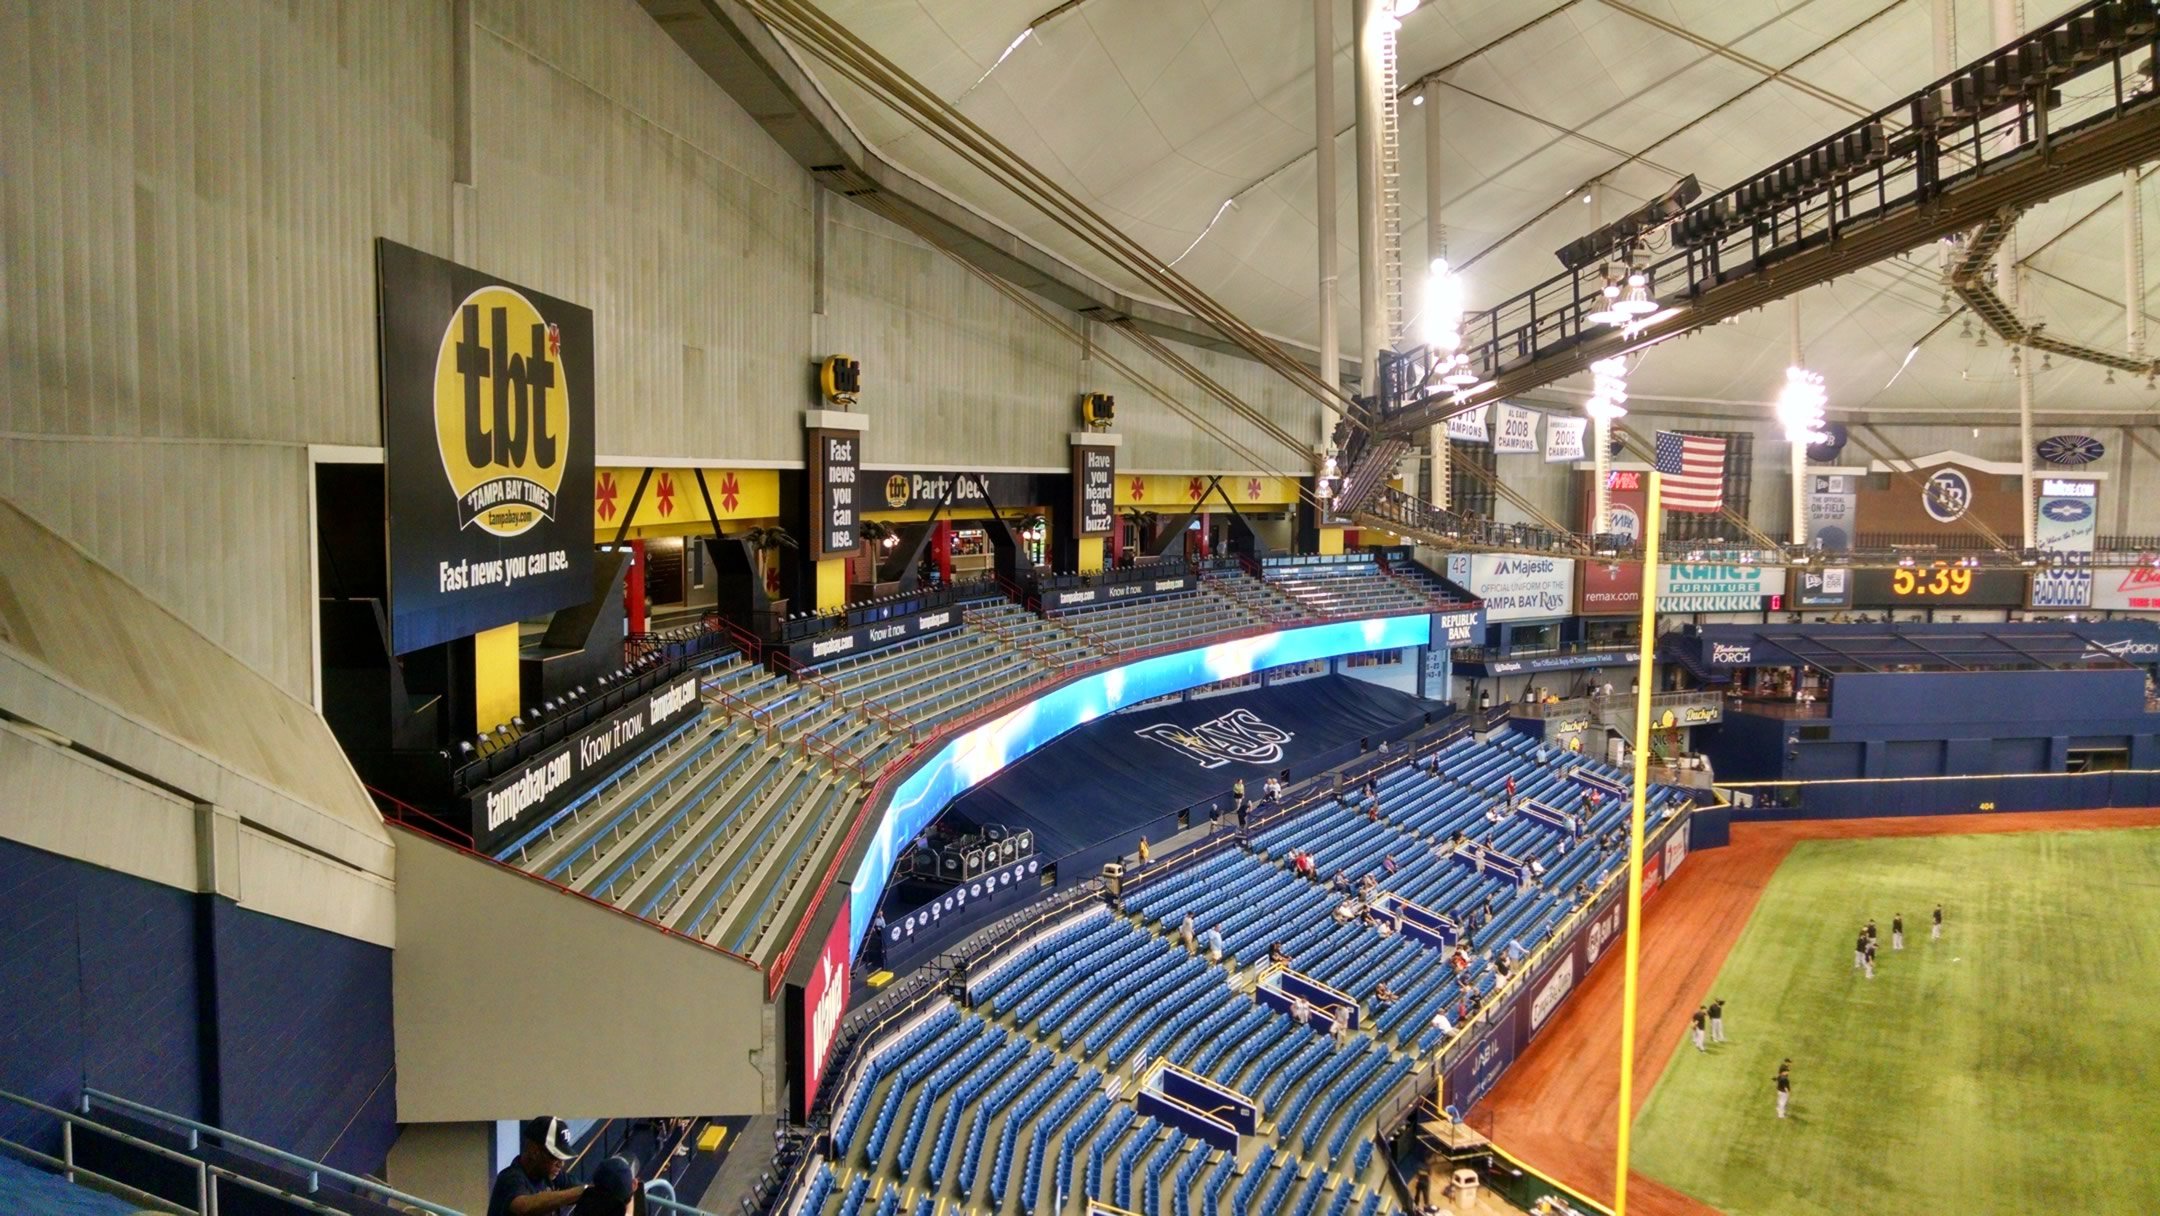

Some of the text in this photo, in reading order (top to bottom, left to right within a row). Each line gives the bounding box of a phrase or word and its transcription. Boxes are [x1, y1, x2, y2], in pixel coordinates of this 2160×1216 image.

[456, 304, 557, 469] tbt
[1505, 420, 1529, 437] 2008
[1498, 436, 1534, 449] CHAMPIONS
[1555, 431, 1575, 446] 2008
[830, 439, 852, 462] Fast
[1548, 447, 1580, 457] CHAMPIONS
[1088, 452, 1110, 468] Have
[829, 465, 856, 483] news
[1091, 471, 1108, 487] you
[472, 480, 550, 511] TAMPA BAY TIMES
[889, 476, 907, 499] tbt
[912, 474, 989, 505] Party Deck
[1086, 483, 1112, 500] heard
[1934, 479, 1963, 512] TB
[833, 487, 852, 509] you
[1091, 500, 1107, 515] the
[1811, 504, 1845, 513] ON-FIELD
[488, 510, 532, 528] tampabay.com
[833, 509, 852, 526] can
[1086, 516, 1112, 532] buzz?
[832, 530, 853, 548] use.
[440, 550, 569, 593] Fast news you can use.
[1452, 557, 1467, 574] 42
[1512, 559, 1554, 577] Majestic
[1893, 560, 1972, 595] 5:39
[1109, 586, 1125, 597] Know
[1126, 586, 1131, 595] it
[1130, 585, 1142, 595] now.
[1481, 584, 1510, 593] OFFICIAL
[1511, 582, 1541, 592] UNIFORM
[1553, 581, 1564, 589] THE
[1672, 583, 1756, 592] FURNITURE
[2033, 580, 2090, 604] RADIOLOGY
[1519, 595, 1538, 607] BAY
[1585, 592, 1639, 601] remax.com
[1441, 613, 1478, 628] REPUBLIC
[812, 635, 853, 658] tampabay.com
[869, 628, 887, 642] Know
[887, 625, 894, 637] it
[894, 624, 906, 637] now.
[1448, 626, 1471, 640] BANK
[2126, 643, 2159, 654] PORCH
[1713, 652, 1751, 663] PORCH
[1685, 706, 1718, 724] Ducky's
[1559, 717, 1588, 734] Ducky's
[487, 677, 696, 831] tampabay.com Know it now. tampabay.com
